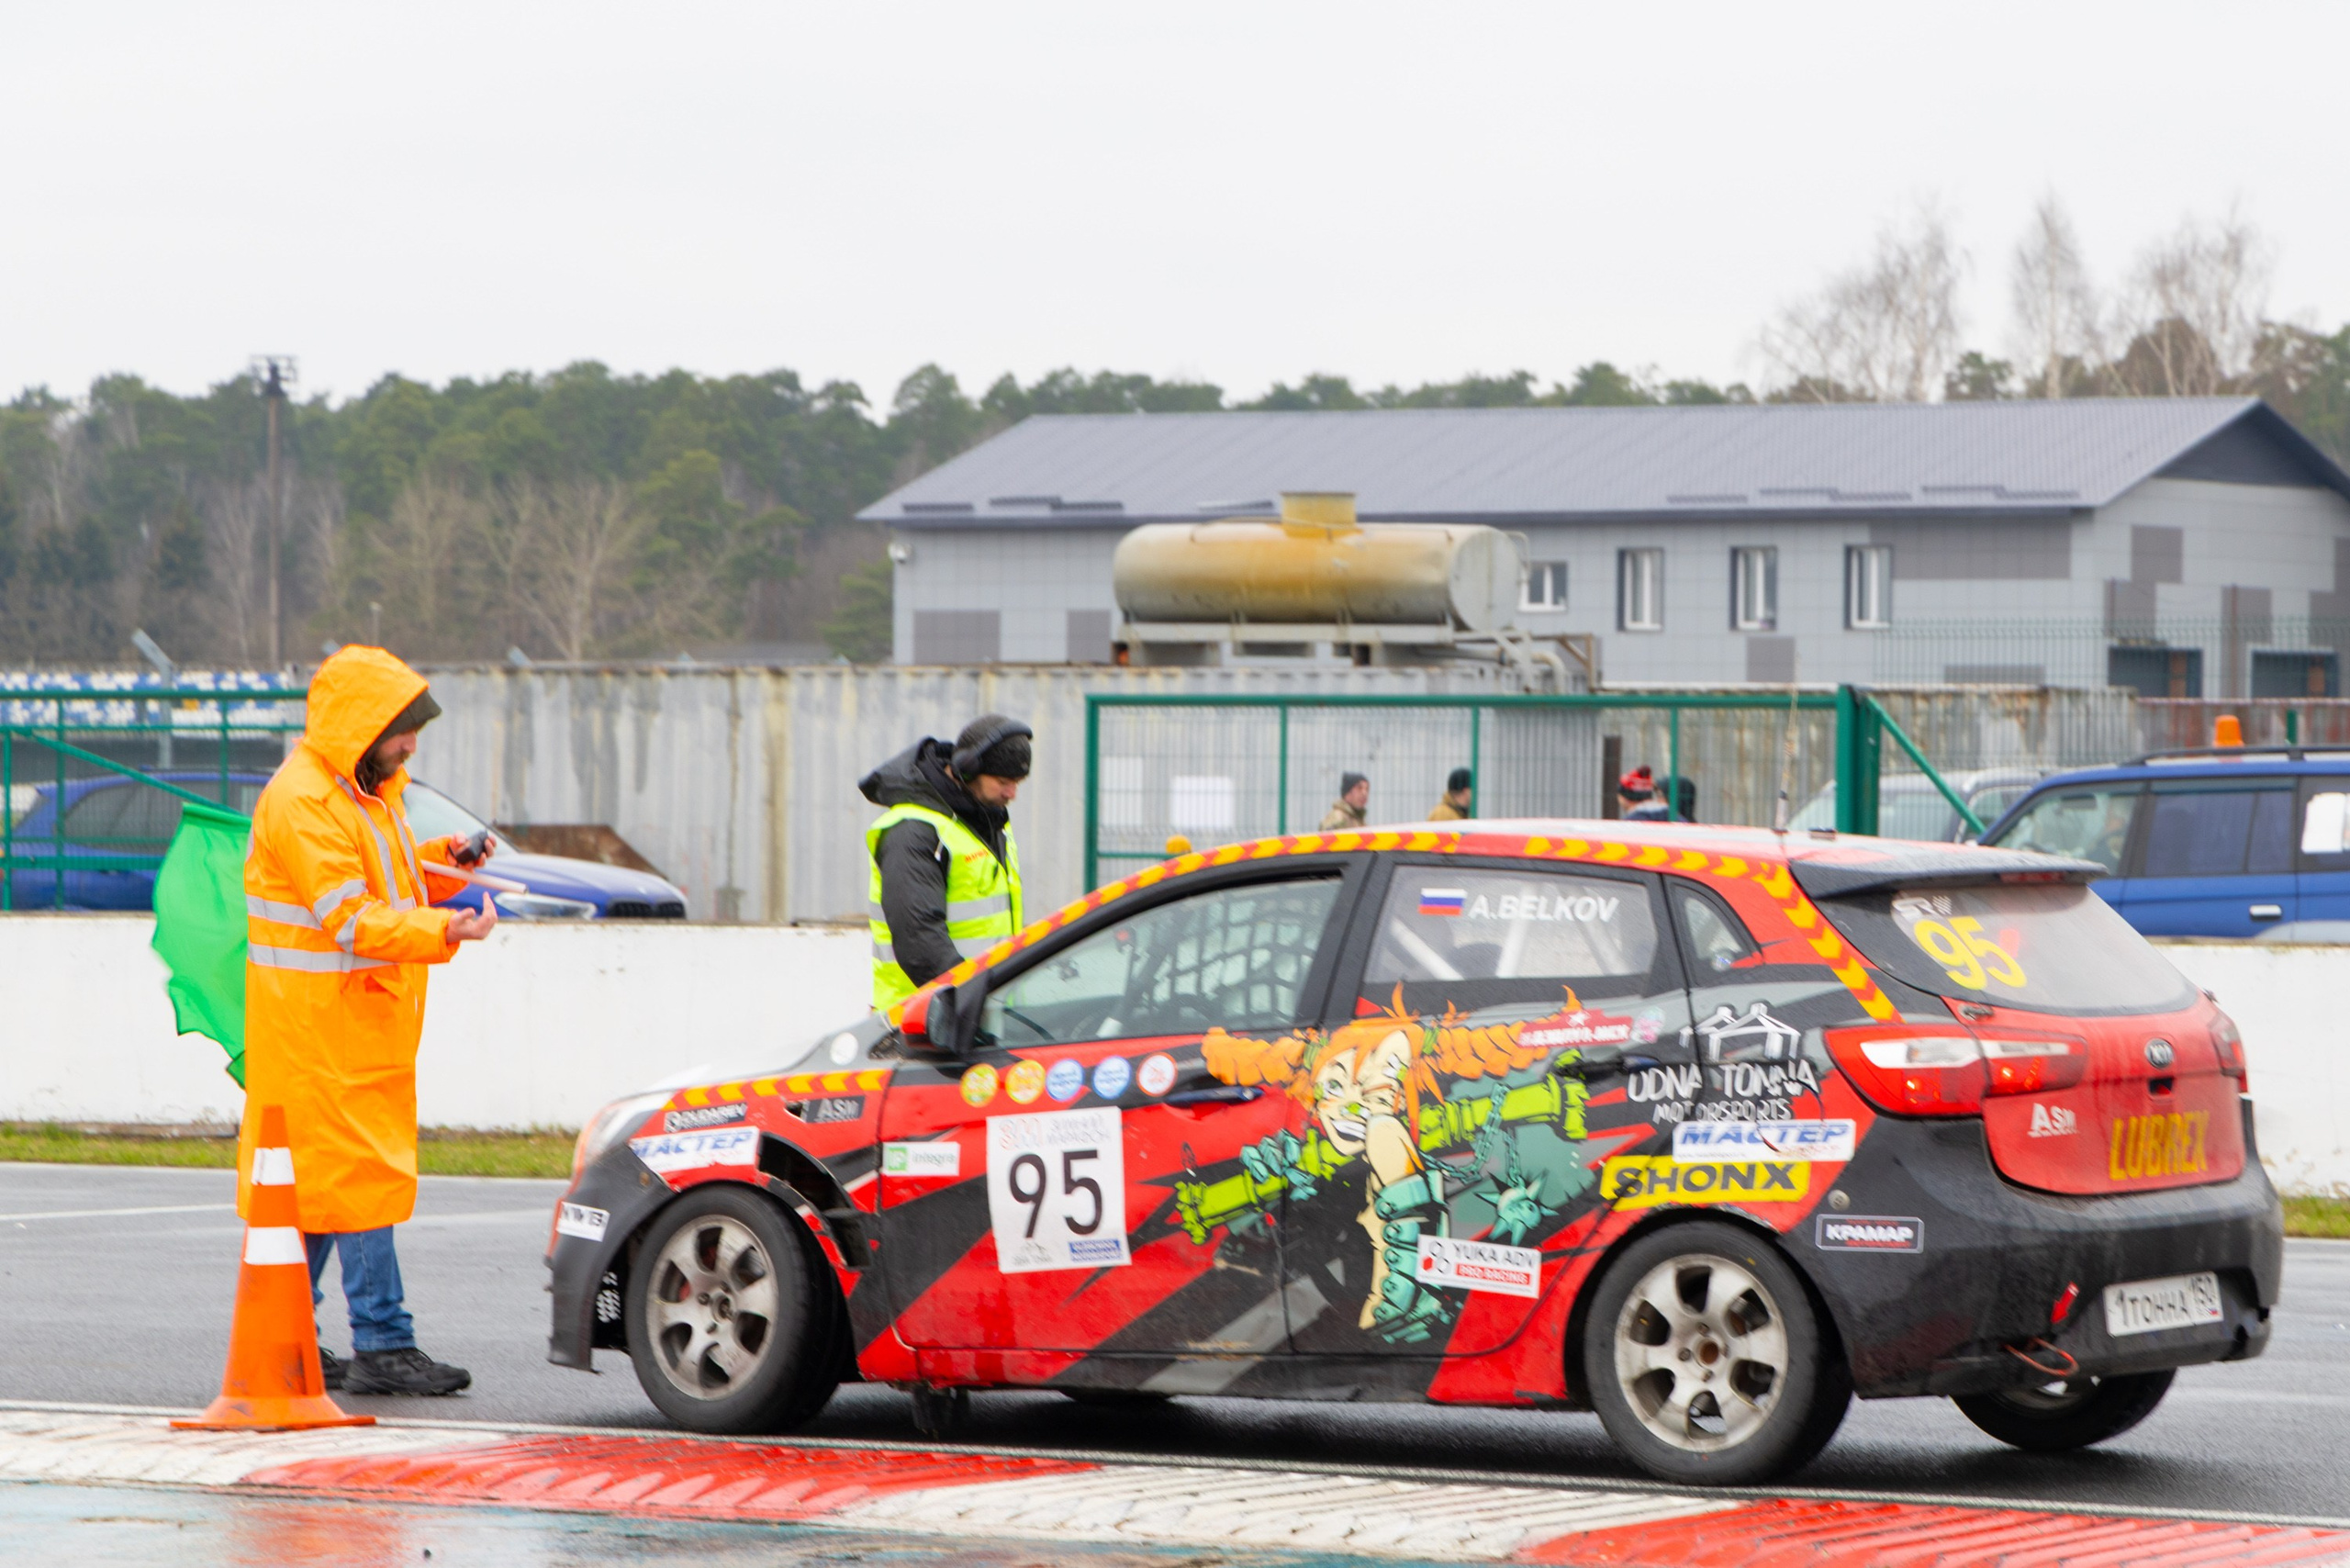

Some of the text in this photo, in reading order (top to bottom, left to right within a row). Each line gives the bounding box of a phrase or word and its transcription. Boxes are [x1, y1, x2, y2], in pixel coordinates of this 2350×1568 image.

[1469, 894, 1620, 923] A.BELKOV
[1913, 915, 2028, 991] 95
[1009, 1148, 1102, 1240] 95
[1614, 1161, 1797, 1199] SHONX
